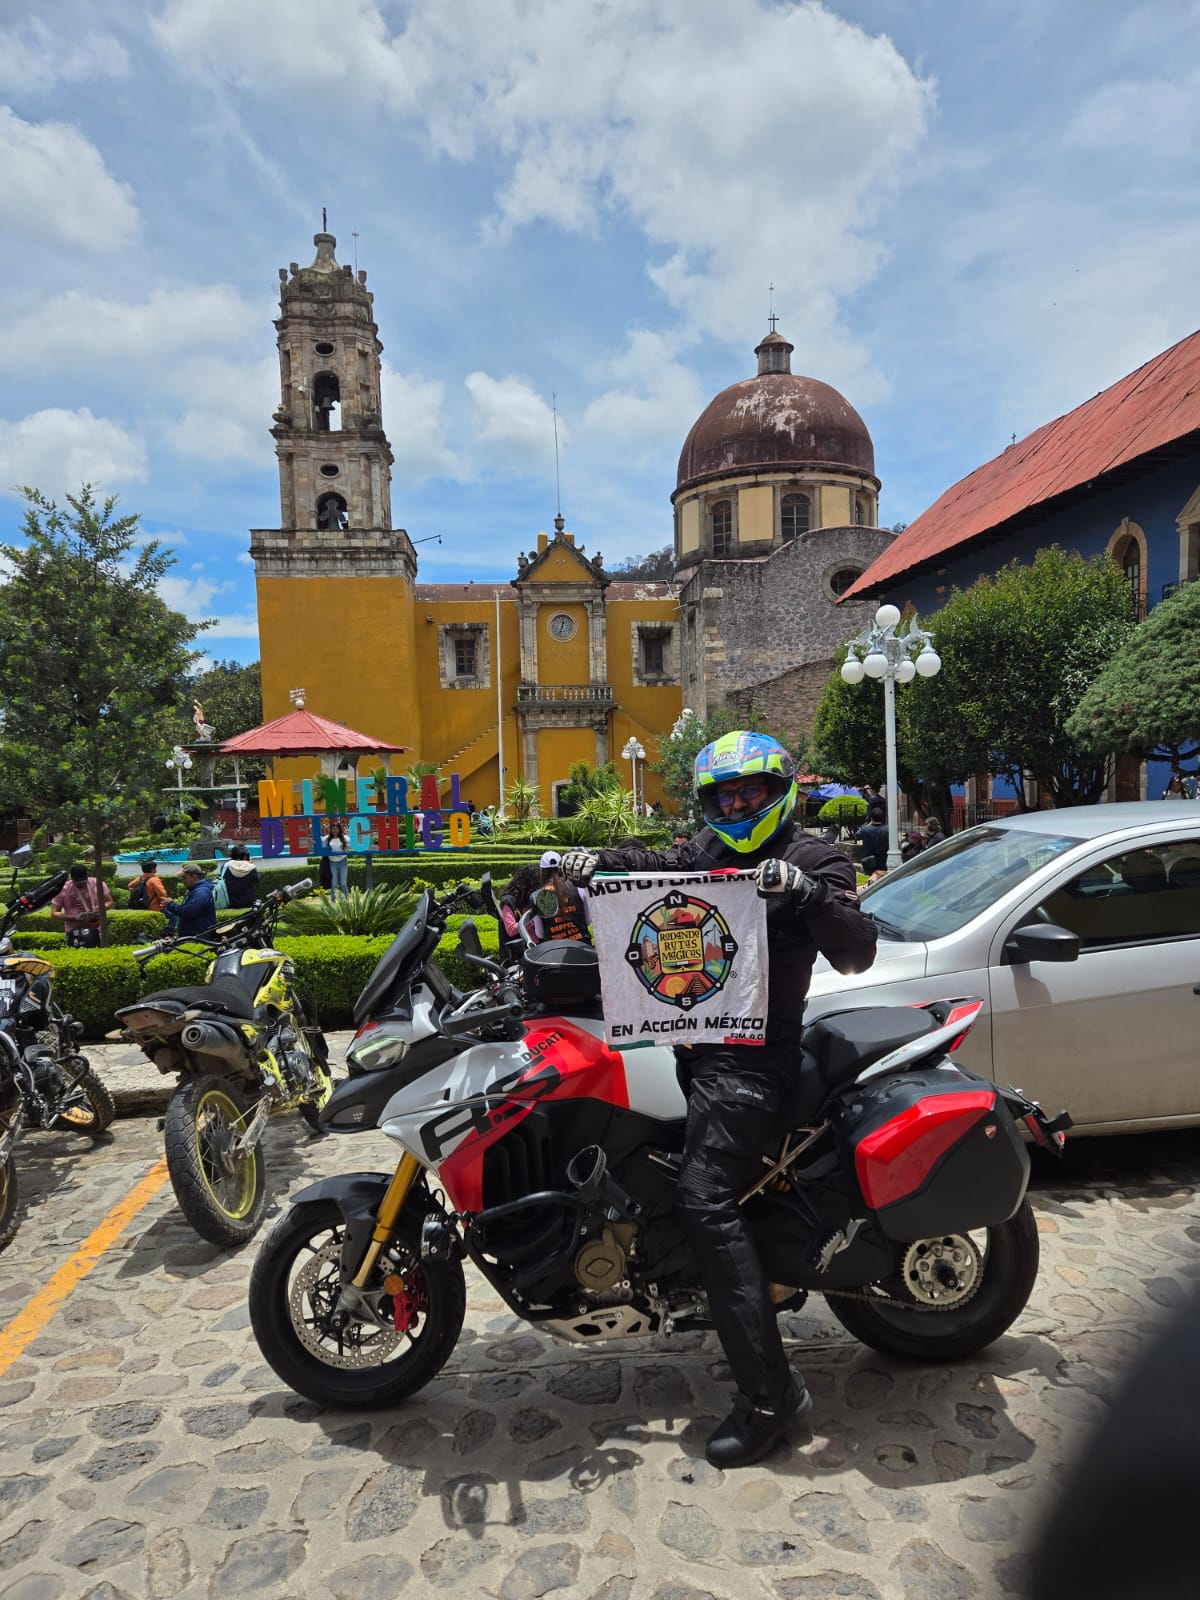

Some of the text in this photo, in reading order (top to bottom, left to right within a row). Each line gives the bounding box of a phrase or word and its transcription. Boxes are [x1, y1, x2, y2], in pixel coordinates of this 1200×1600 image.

[258, 773, 468, 817] MINERAL
[260, 812, 471, 857] DEL CHICO
[670, 895, 682, 905] N
[725, 942, 735, 952] E
[682, 997, 691, 1006] S
[611, 1012, 764, 1037] EN ACCIÓN MÉXICO
[520, 1031, 565, 1062] DUCATI
